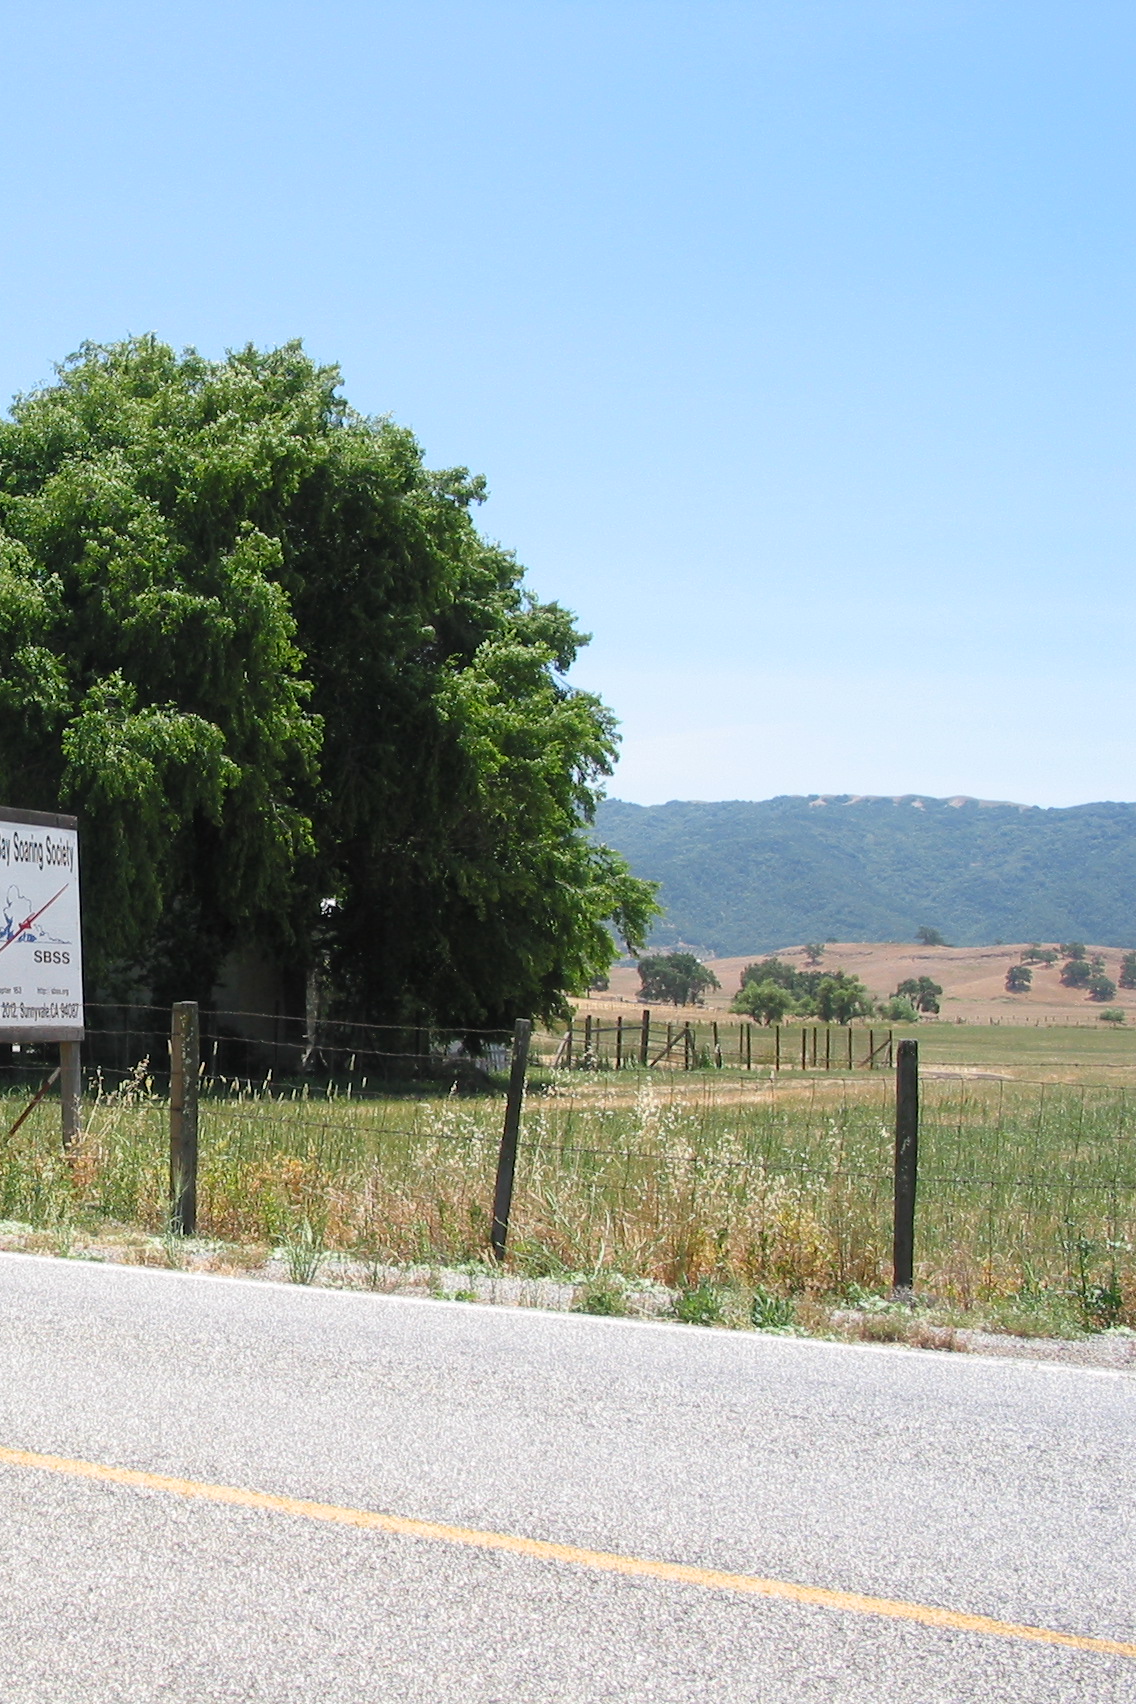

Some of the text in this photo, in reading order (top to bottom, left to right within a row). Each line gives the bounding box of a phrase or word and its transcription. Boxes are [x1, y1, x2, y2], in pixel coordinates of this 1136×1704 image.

[13, 831, 43, 870] Soaring
[46, 835, 74, 873] Society
[33, 949, 70, 964] SBSS
[50, 1002, 59, 1018] CA
